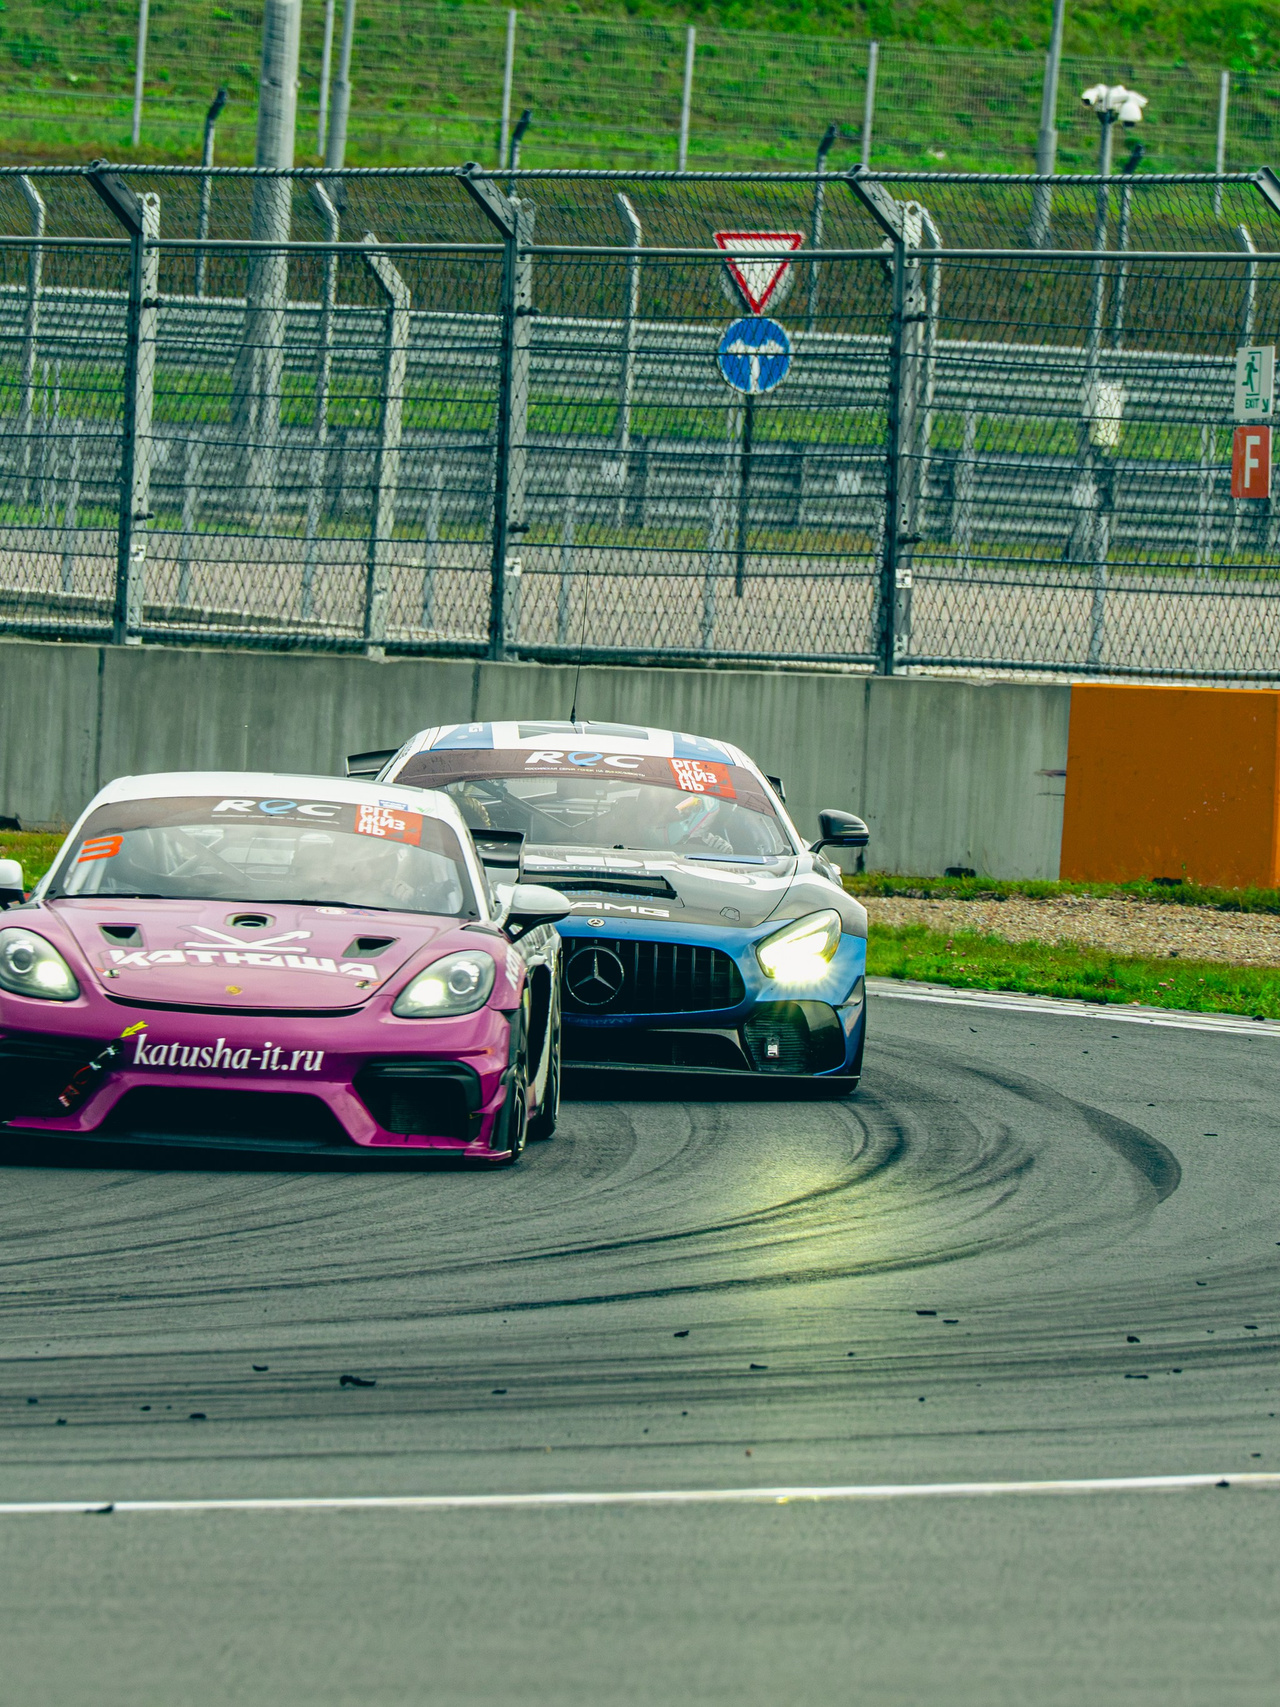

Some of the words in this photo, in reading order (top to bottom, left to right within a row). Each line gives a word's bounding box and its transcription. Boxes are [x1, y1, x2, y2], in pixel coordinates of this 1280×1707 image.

[1245, 398, 1259, 409] EXIT
[1244, 435, 1261, 488] F
[671, 759, 703, 772] РГС
[360, 805, 394, 818] РГС
[571, 902, 670, 918] AMG
[133, 1034, 325, 1072] katusha-it.ru
